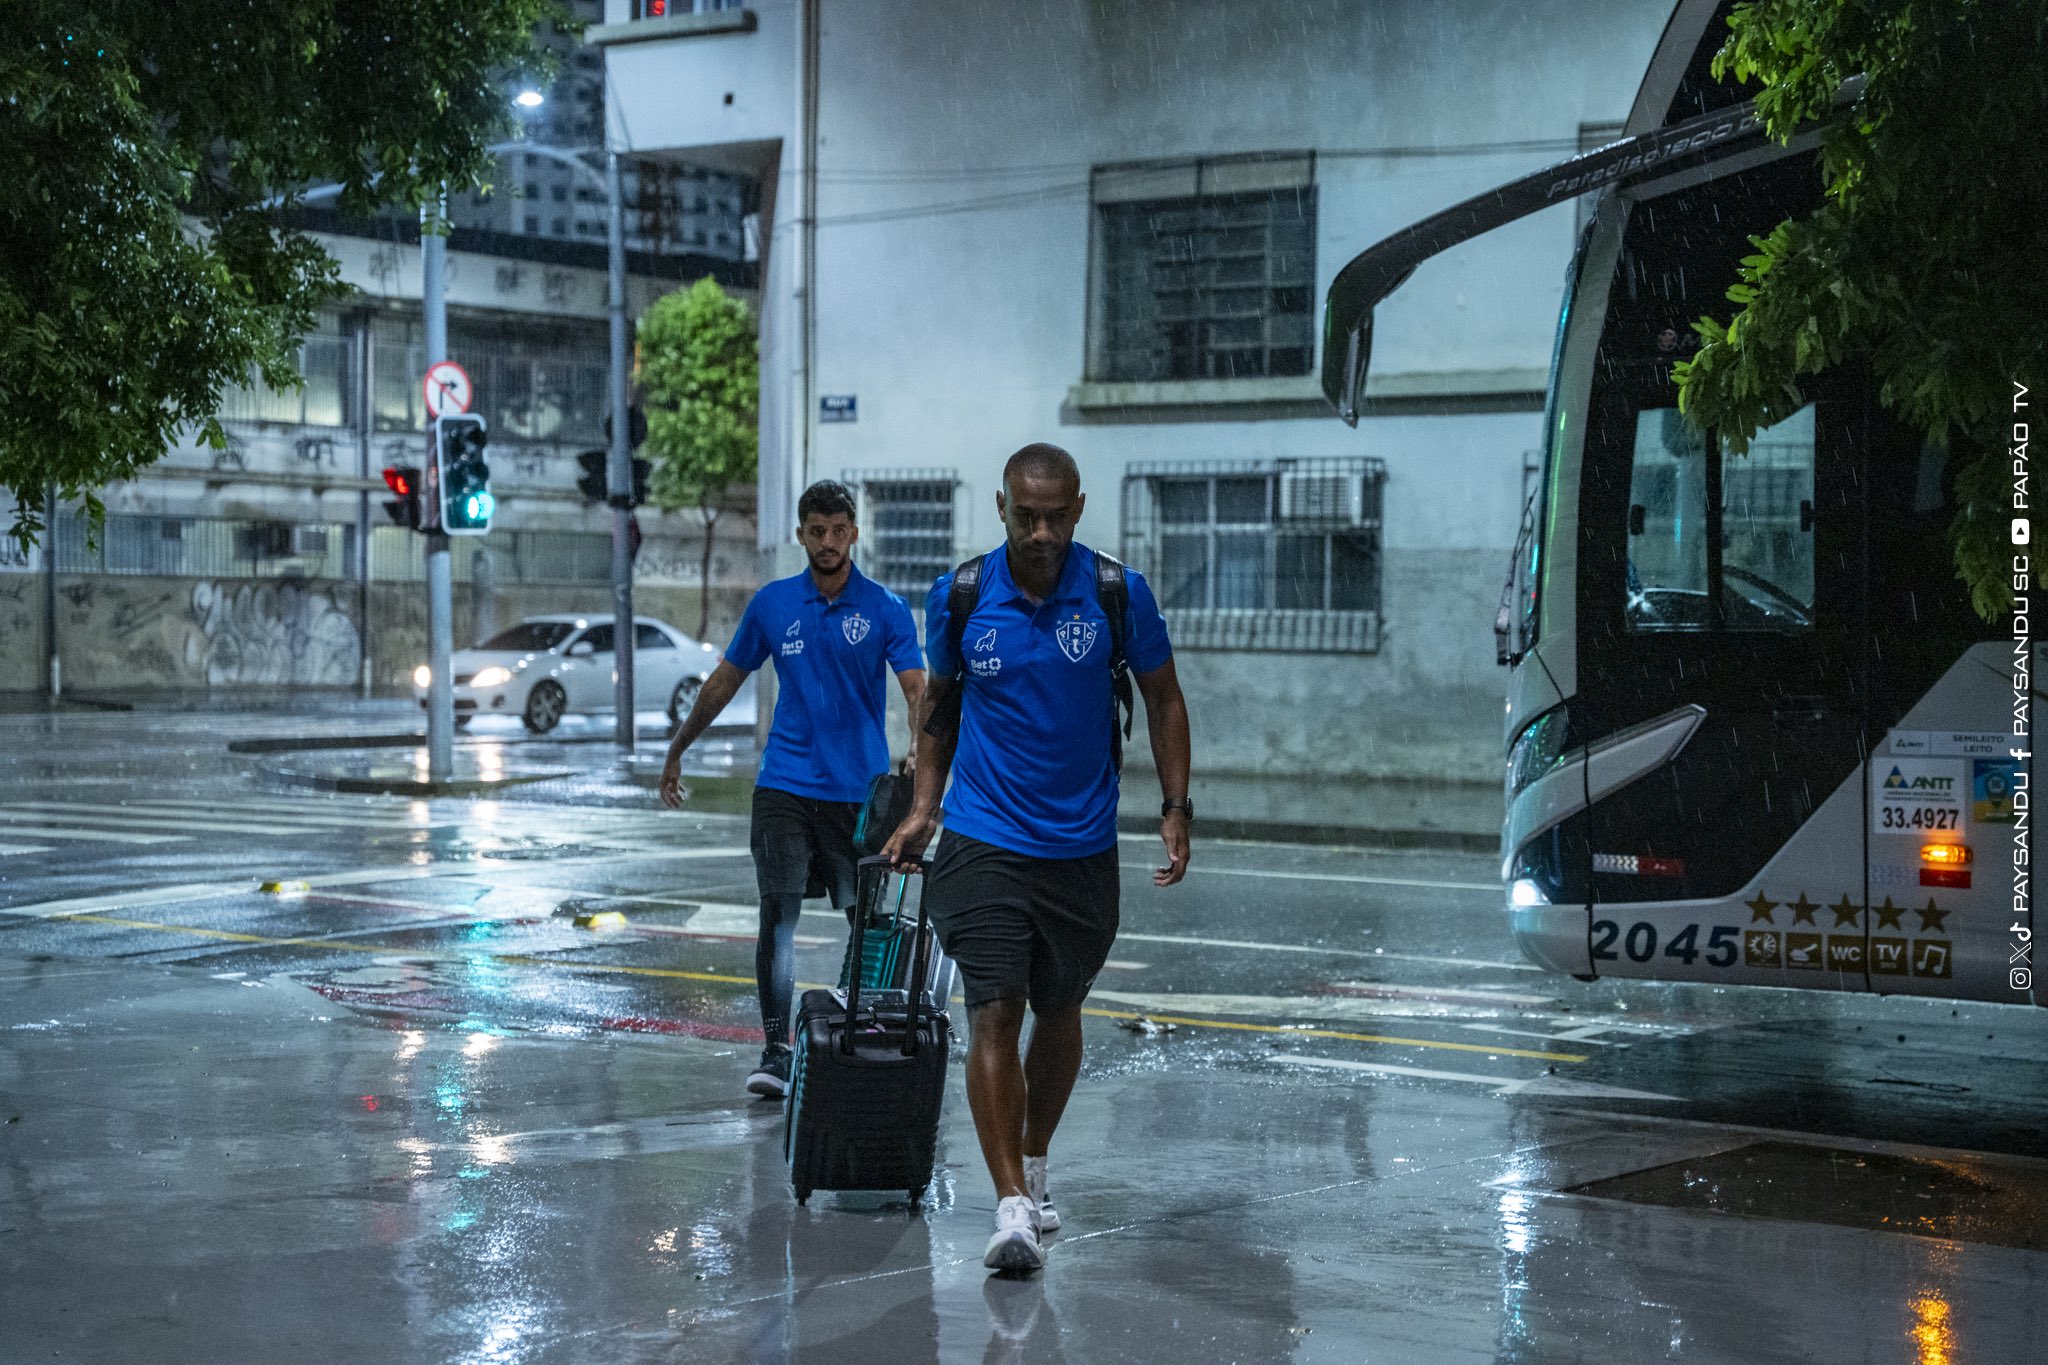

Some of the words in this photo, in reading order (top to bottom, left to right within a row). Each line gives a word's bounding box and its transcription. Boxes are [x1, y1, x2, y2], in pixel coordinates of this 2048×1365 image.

[1546, 149, 1658, 198] Paradiso
[970, 659, 988, 670] Bet
[1952, 734, 2005, 744] SEMILEITO
[1964, 745, 1993, 753] LEITO
[1911, 776, 1955, 790] ANTT
[1882, 806, 1960, 830] 33.4927
[1591, 919, 1741, 968] 2045
[1831, 945, 1861, 963] WC
[1875, 944, 1902, 962] TV
